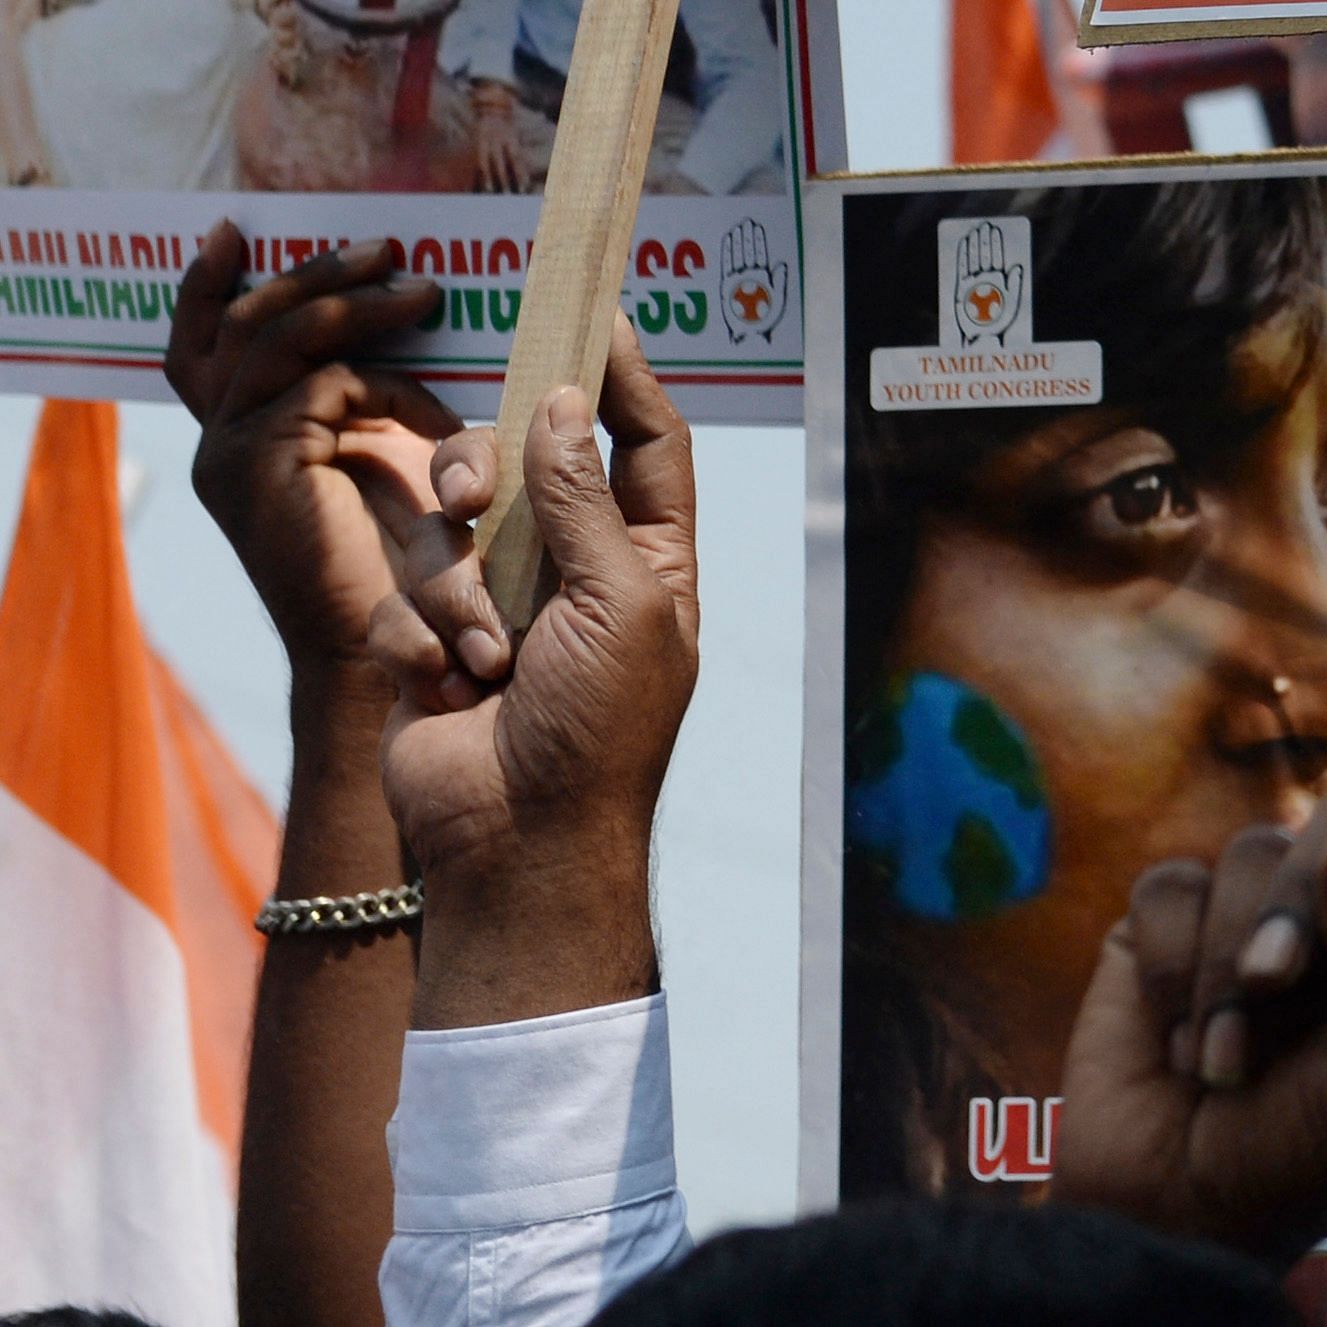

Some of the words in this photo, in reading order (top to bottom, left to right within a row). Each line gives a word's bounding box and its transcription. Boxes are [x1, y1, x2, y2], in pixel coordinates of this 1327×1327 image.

[918, 352, 1057, 376] TAMILNADU
[883, 382, 961, 404] YOUTH
[967, 378, 1092, 401] CONGRESS
